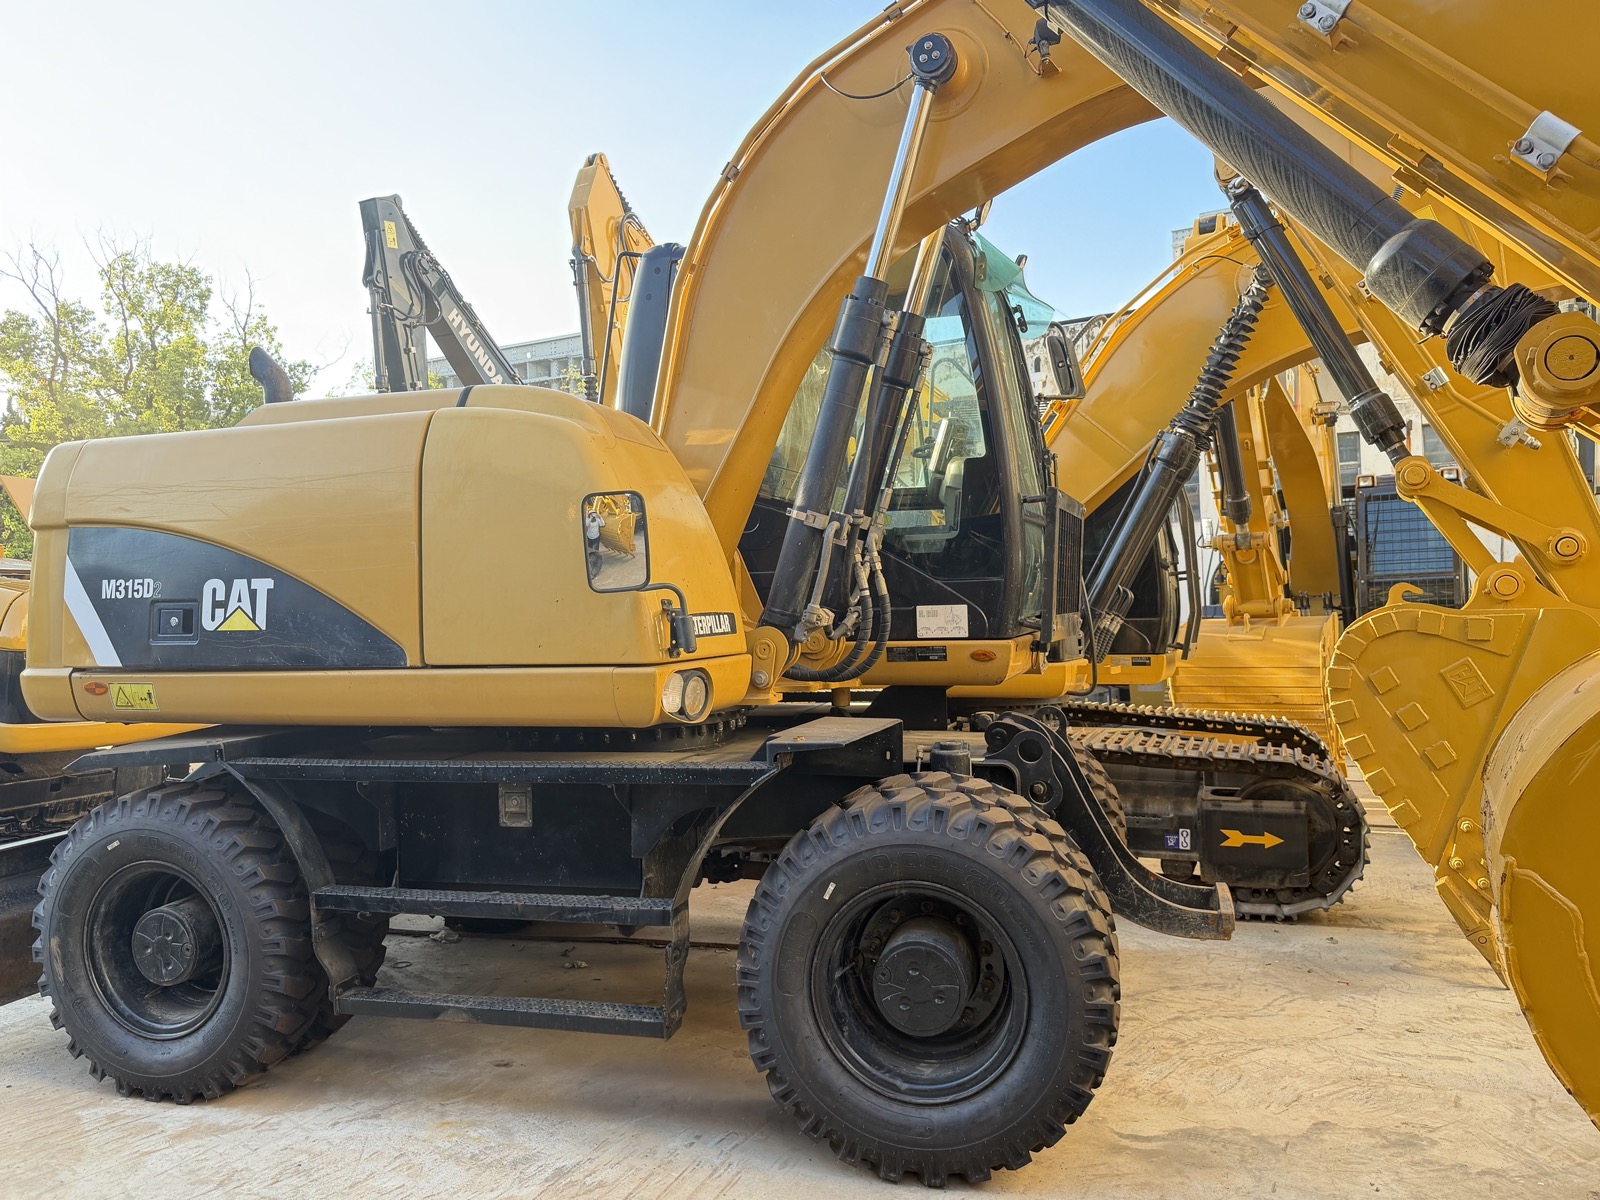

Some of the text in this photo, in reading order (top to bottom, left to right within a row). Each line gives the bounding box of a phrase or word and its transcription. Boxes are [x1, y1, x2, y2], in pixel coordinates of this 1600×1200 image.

[448, 308, 507, 385] HYUNDA
[202, 577, 274, 632] CAT
[692, 614, 731, 635] TERPILLAR
[1447, 663, 1489, 703] CAT
